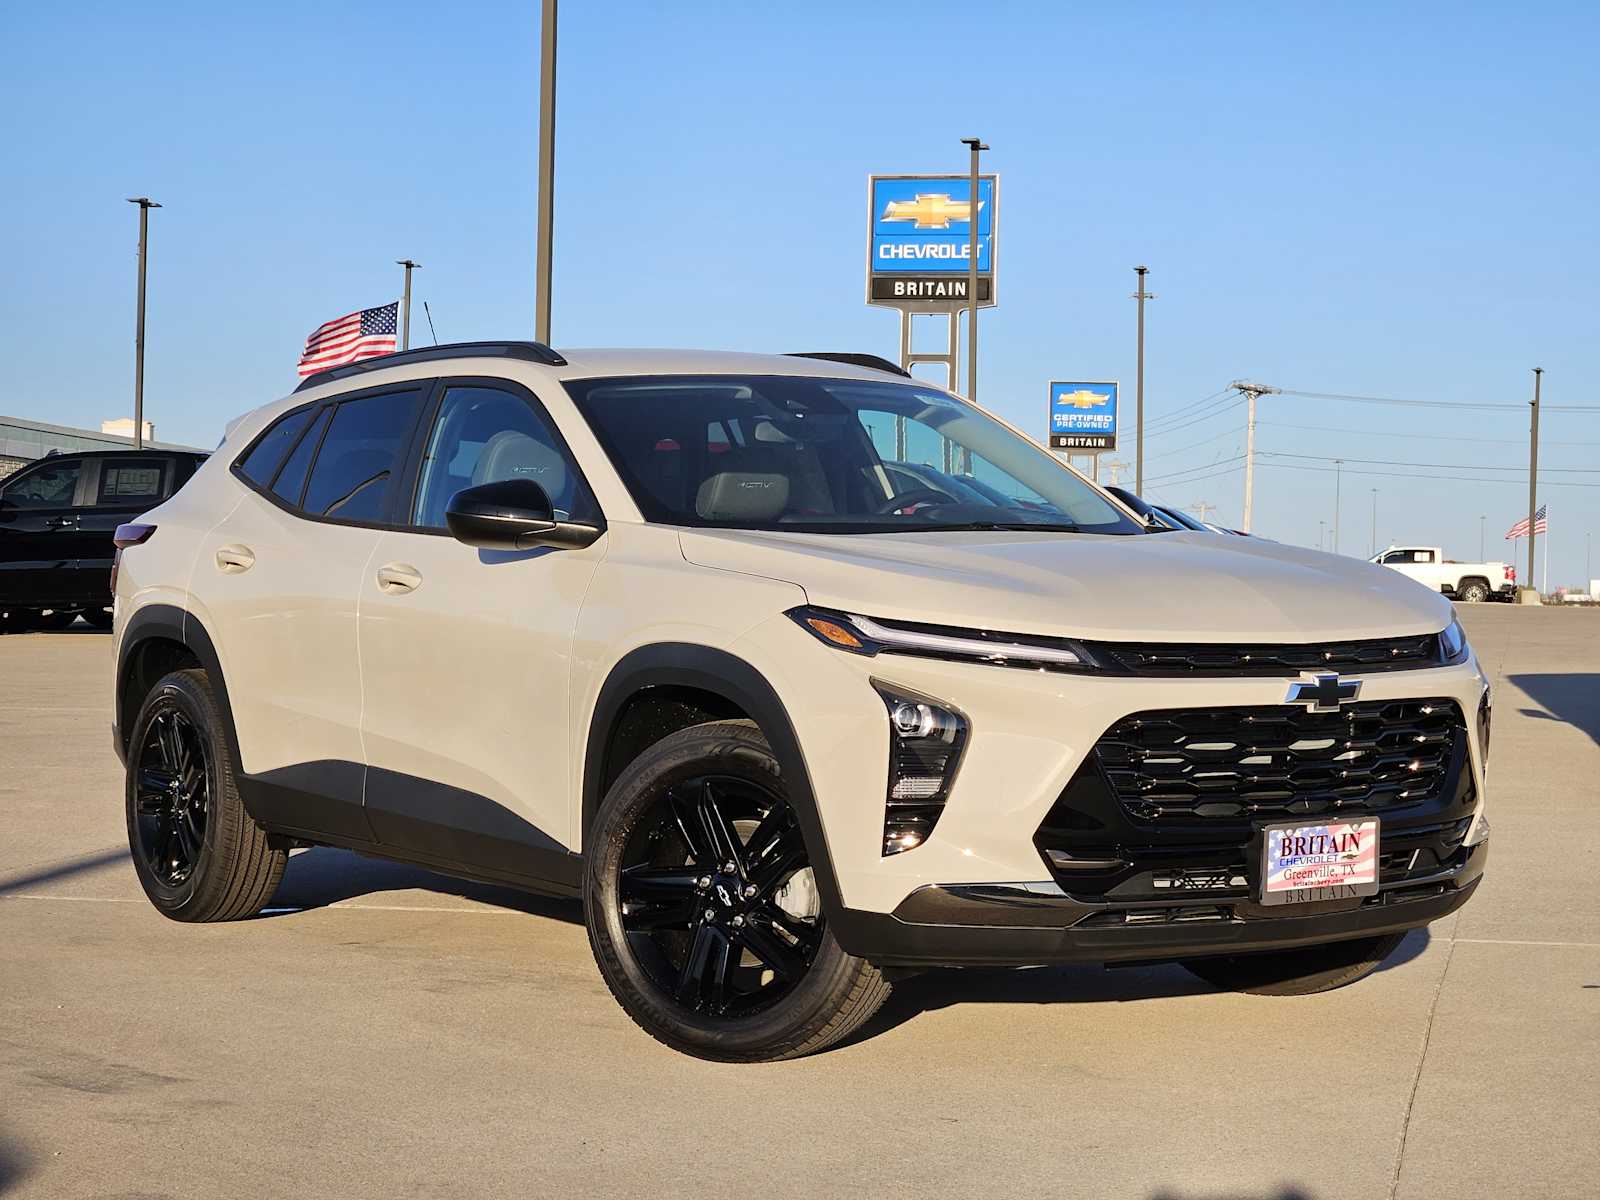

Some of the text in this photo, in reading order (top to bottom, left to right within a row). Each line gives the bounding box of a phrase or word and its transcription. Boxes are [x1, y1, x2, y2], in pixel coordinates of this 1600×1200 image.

[880, 244, 983, 258] CHEVROLET
[894, 282, 966, 296] BRITAIN
[1053, 413, 1113, 422] CERTIFIED
[1056, 421, 1110, 429] PRE-OWNED
[1059, 437, 1105, 447] BRITAIN
[1281, 833, 1361, 857] BRITAIN
[1280, 855, 1339, 867] CHEVROLET
[1283, 864, 1356, 880] Greenville, TX
[1286, 884, 1358, 903] BRITAIN
